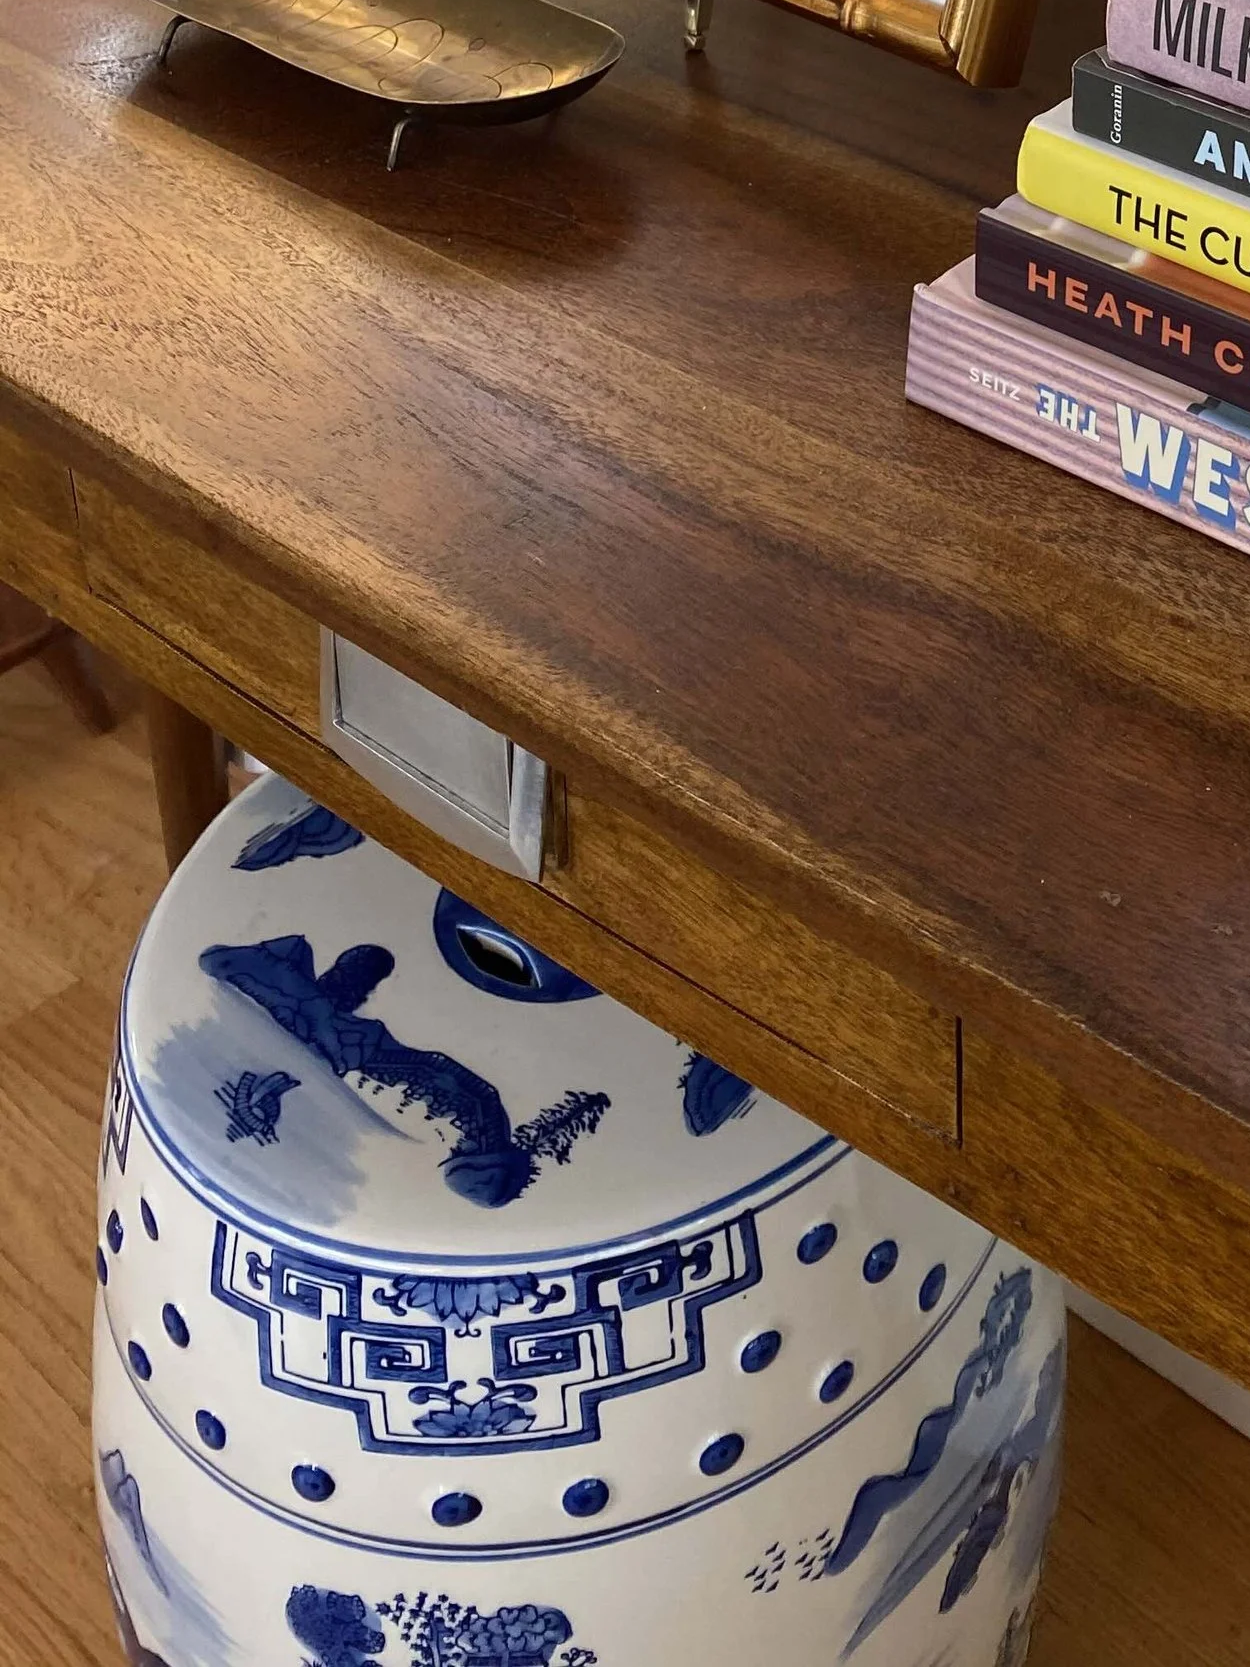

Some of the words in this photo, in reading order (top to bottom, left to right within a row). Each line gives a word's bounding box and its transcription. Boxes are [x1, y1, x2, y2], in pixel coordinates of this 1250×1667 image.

[1110, 84, 1123, 144] Goranin
[1109, 185, 1189, 251] THE
[1027, 261, 1192, 355] HEATH
[969, 367, 1021, 401] SEITZ
[1036, 385, 1101, 443] THE
